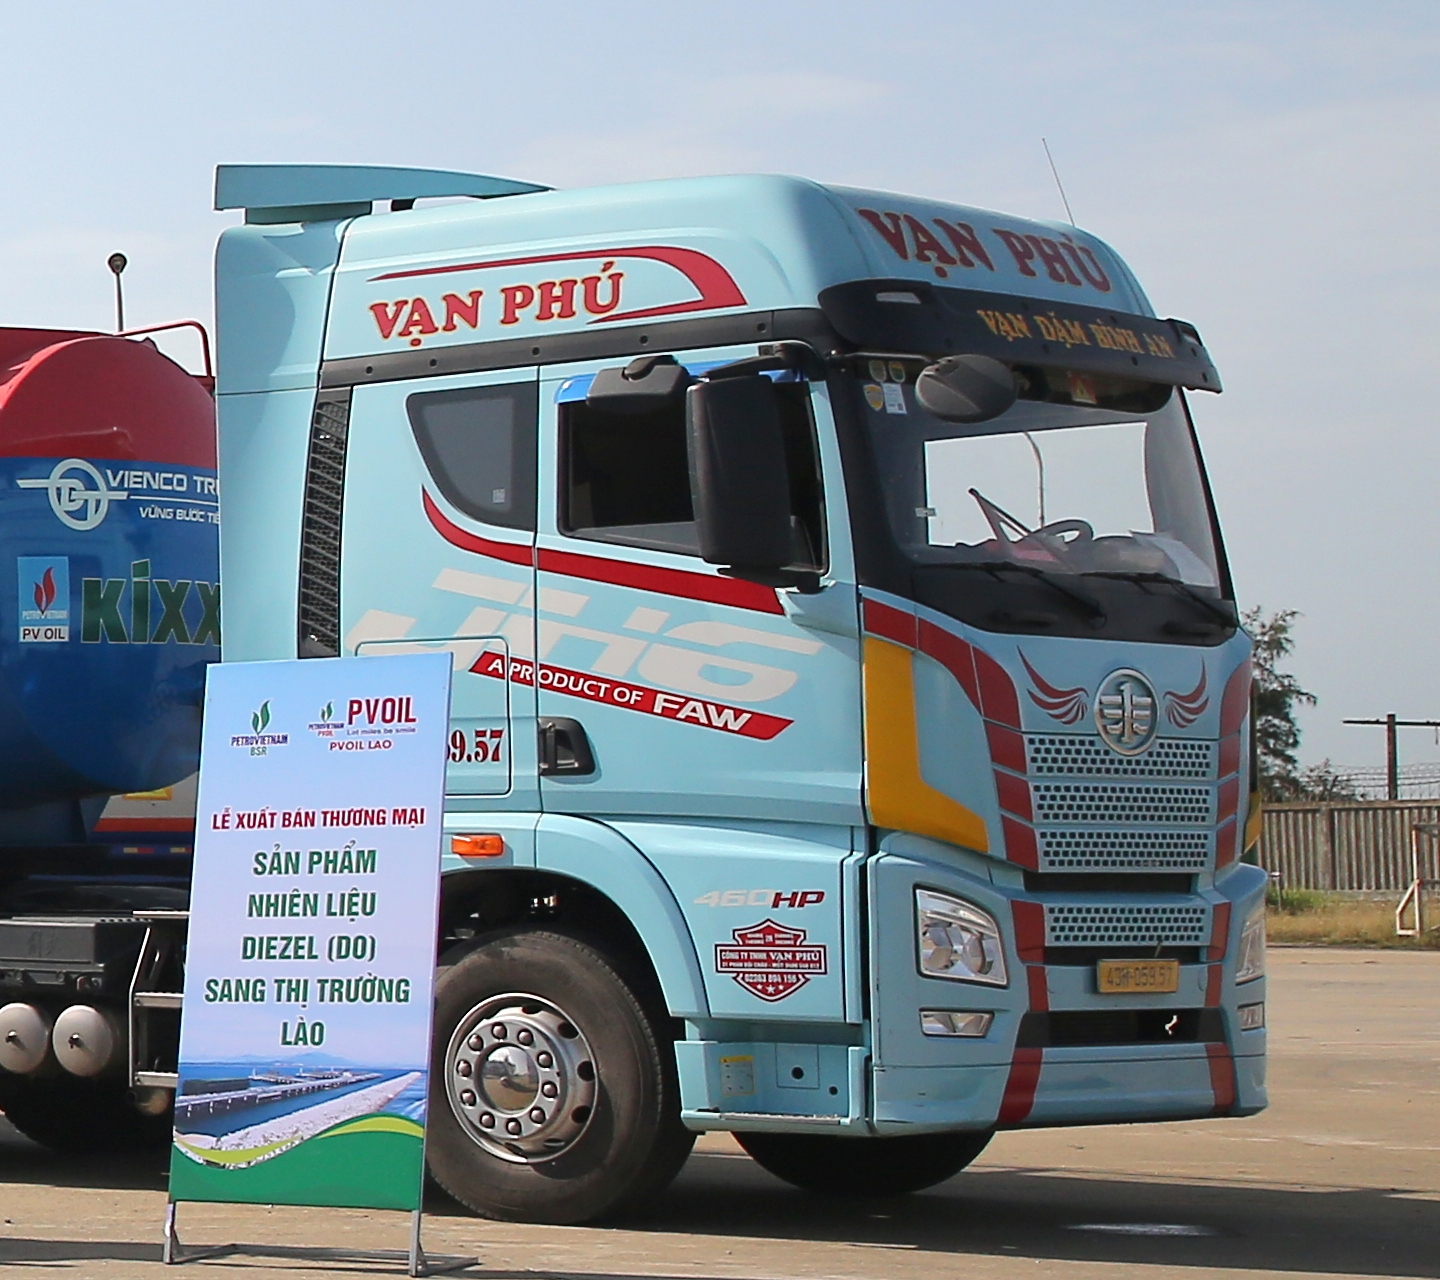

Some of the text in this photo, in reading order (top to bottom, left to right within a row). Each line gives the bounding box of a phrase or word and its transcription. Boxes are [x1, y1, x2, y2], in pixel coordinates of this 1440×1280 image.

[856, 208, 1112, 294] VẠN PHÚ
[368, 260, 625, 348] VẠN PHÚ
[977, 309, 1033, 342] VẠN
[1033, 311, 1091, 349] DẶM
[1143, 333, 1175, 358] AN
[106, 469, 188, 492] VIENCO
[22, 628, 66, 640] PV OIL
[487, 657, 752, 732] A PRODUCT OF FAW
[347, 697, 417, 726] PVOIL
[230, 733, 288, 747] PETROVIETNAM
[250, 746, 267, 756] BSR
[330, 740, 392, 751] PVOIL LAO
[211, 804, 426, 831] LỄ XUẤT BÁN THƯƠNG MẠI
[252, 839, 377, 876] SẢN PHẨM
[246, 888, 378, 923] NHIÊN LIỆU
[693, 889, 825, 909] 460HP
[241, 934, 377, 962] DIEZEL (DO)
[795, 950, 820, 961] PHÚ
[204, 968, 411, 1009] SANG THỊ TRƯỜNG
[280, 1016, 325, 1047] LÀO
